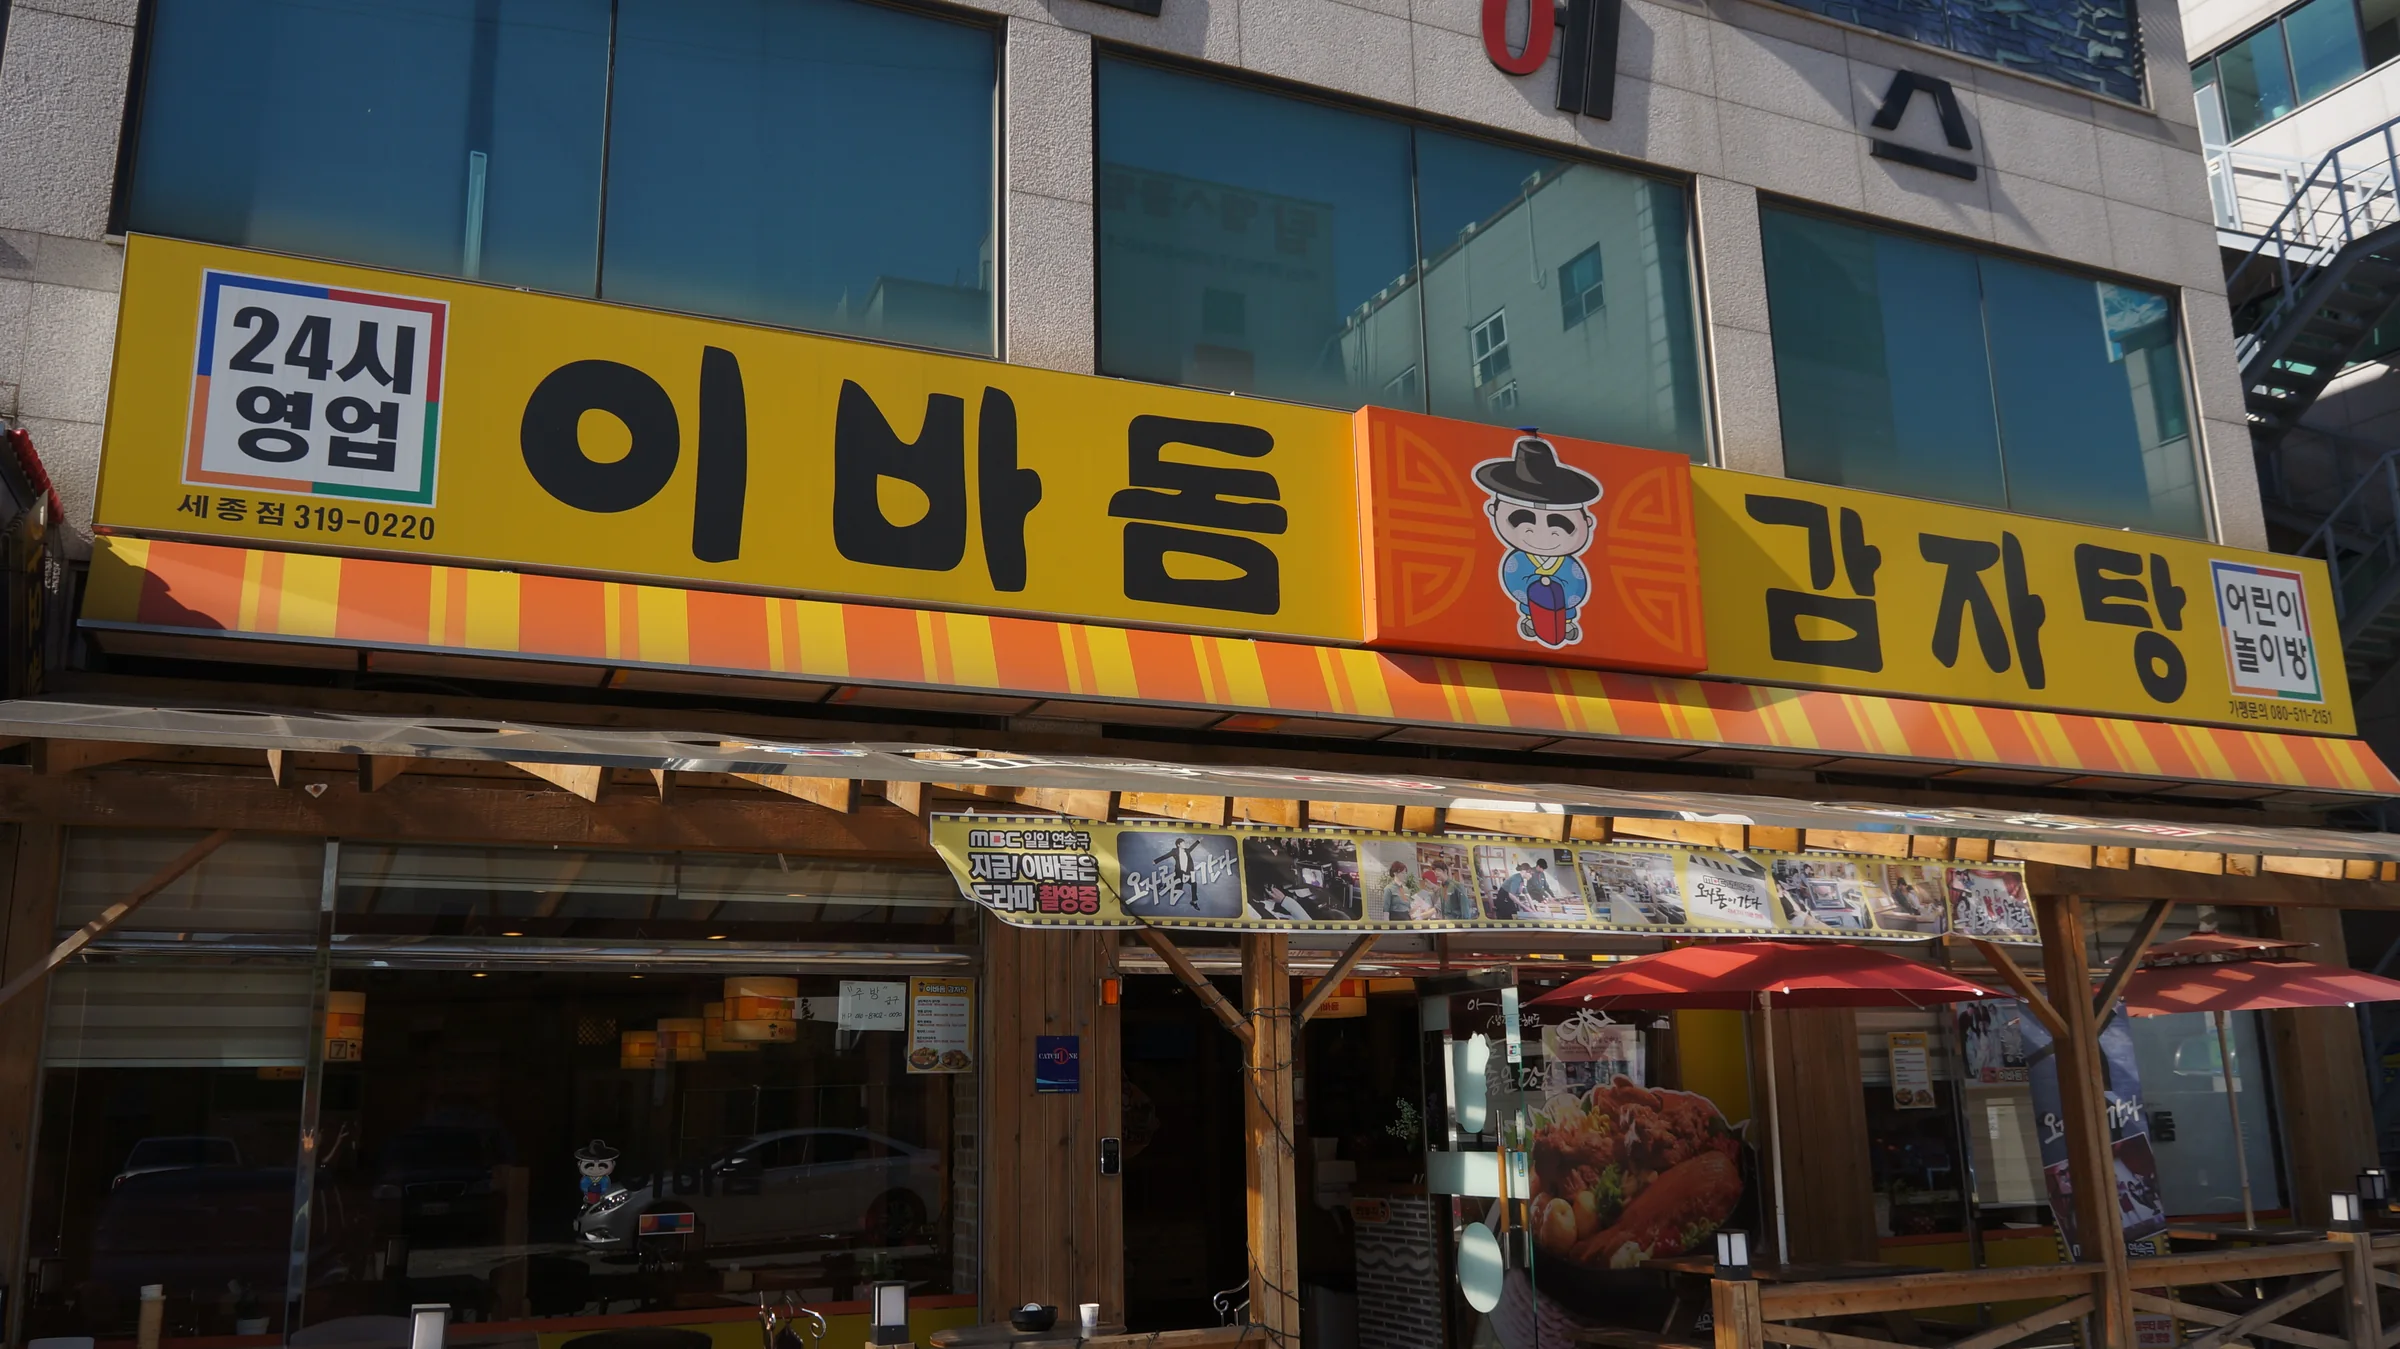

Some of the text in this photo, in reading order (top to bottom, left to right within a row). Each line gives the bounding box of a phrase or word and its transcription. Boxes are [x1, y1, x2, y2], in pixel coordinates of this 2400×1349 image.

[228, 306, 416, 395] 24시
[236, 385, 401, 472] 영업
[293, 504, 435, 541] 319-0220
[520, 344, 2187, 704] 이바돔 감자탕
[2226, 583, 2302, 632] 어린이
[2232, 629, 2307, 681] 놀이방
[2228, 700, 2333, 725] 가맹문의 080-511-2151
[1024, 831, 1050, 849] 일일
[1051, 832, 1089, 850] 연속극
[971, 854, 1098, 882] 지금! 이바돔은
[973, 884, 1099, 913] 드라마 촬영중
[1737, 894, 1763, 910] 간다
